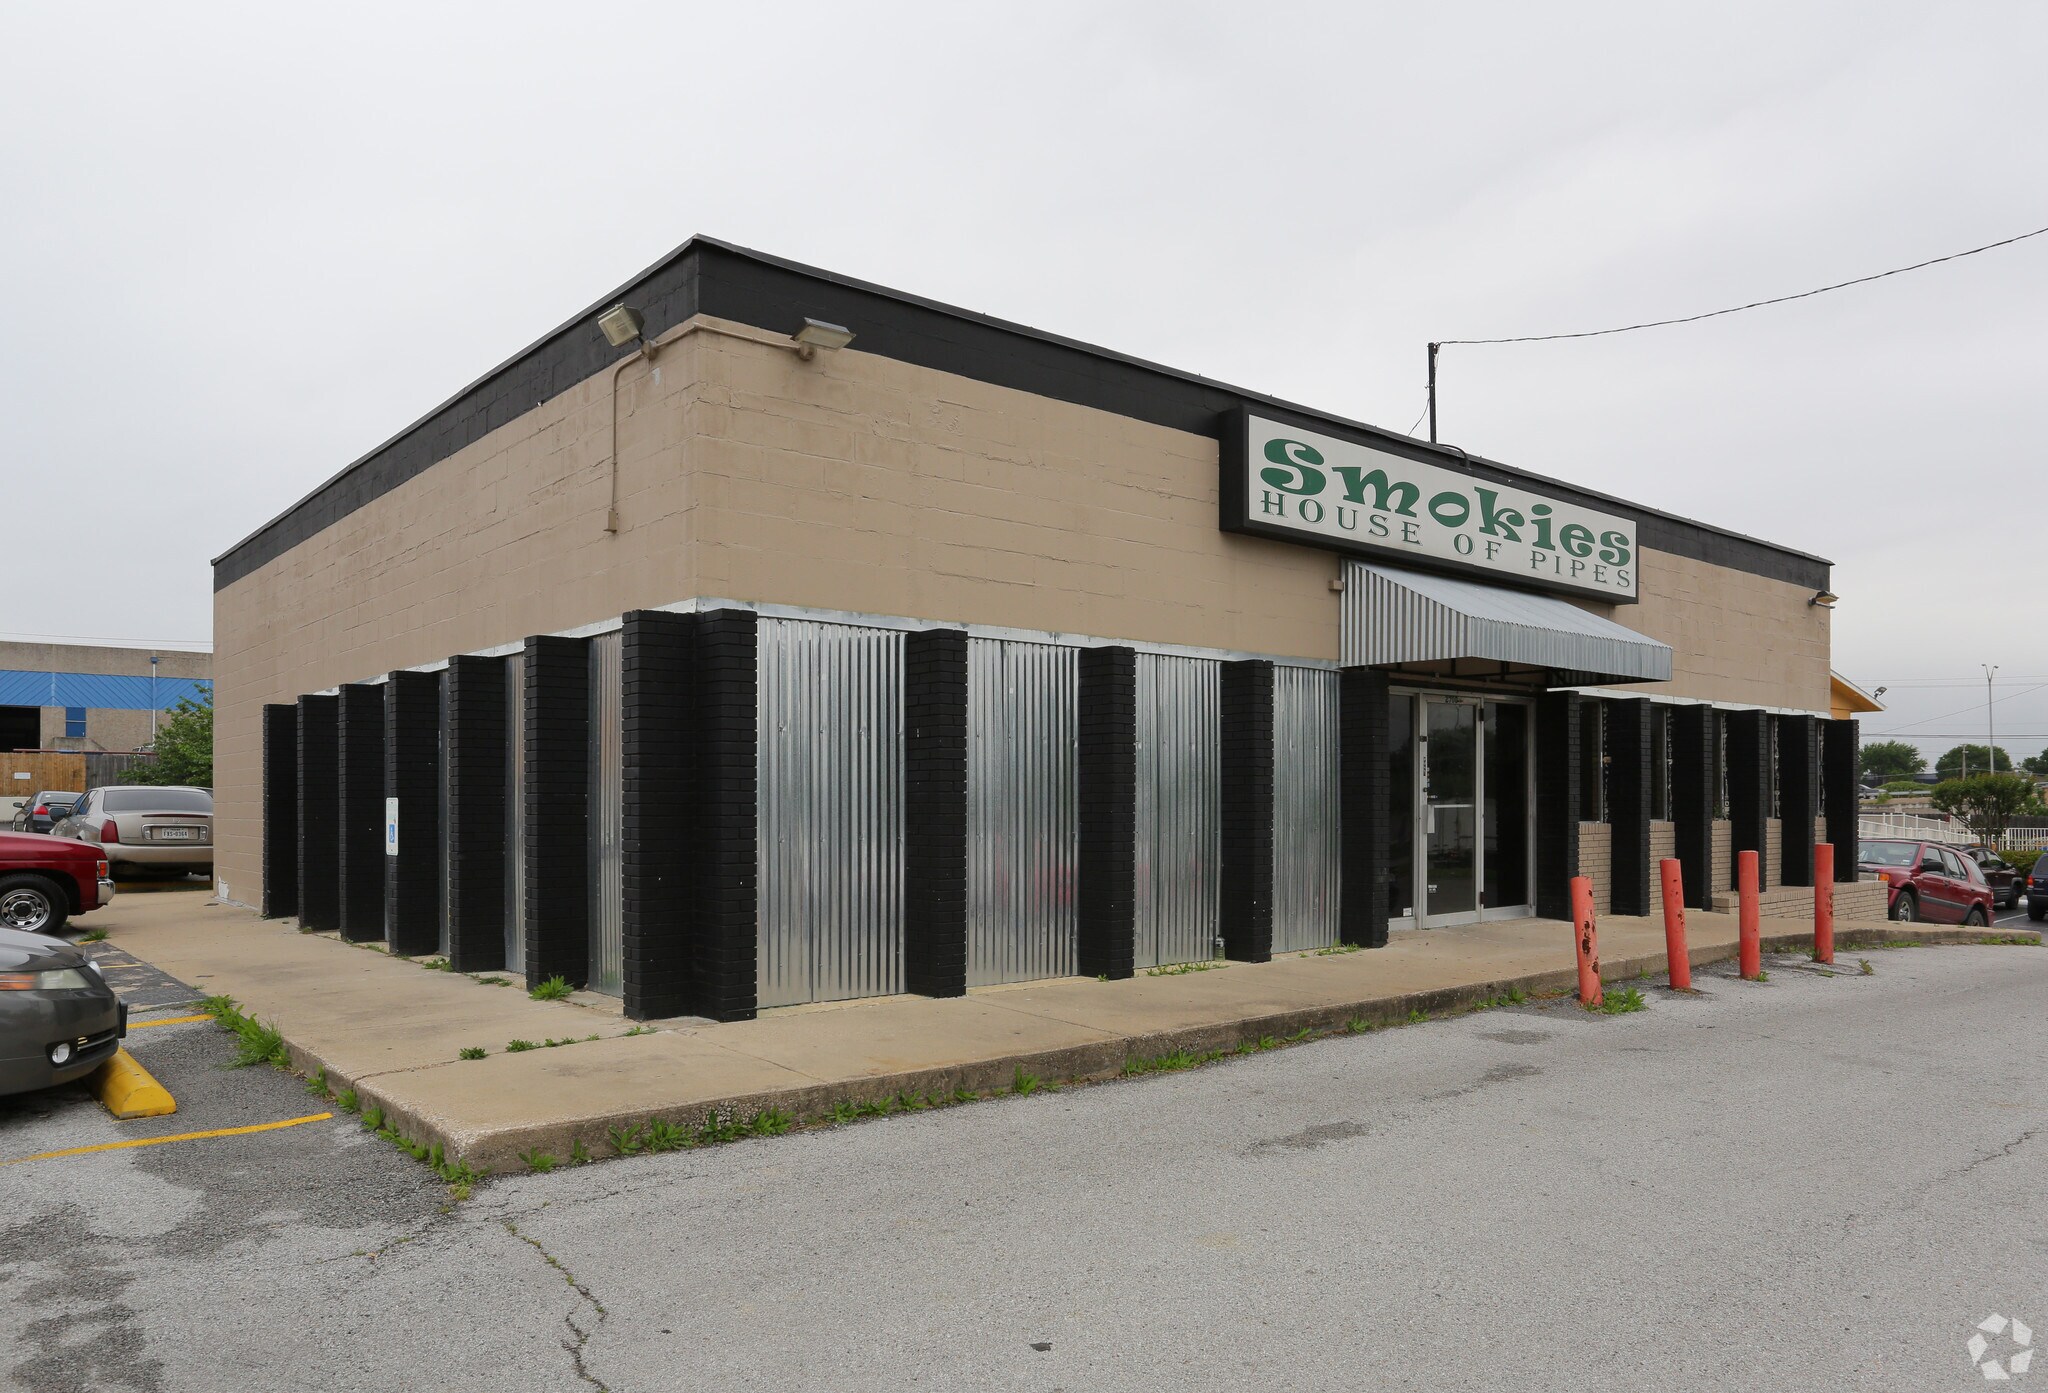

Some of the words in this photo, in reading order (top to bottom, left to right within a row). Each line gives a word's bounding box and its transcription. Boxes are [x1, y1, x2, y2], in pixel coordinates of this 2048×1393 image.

[1260, 438, 1631, 566] Smokies
[1260, 490, 1422, 545] HOUSE
[1453, 533, 1502, 561] OF
[1530, 550, 1630, 588] PIPES
